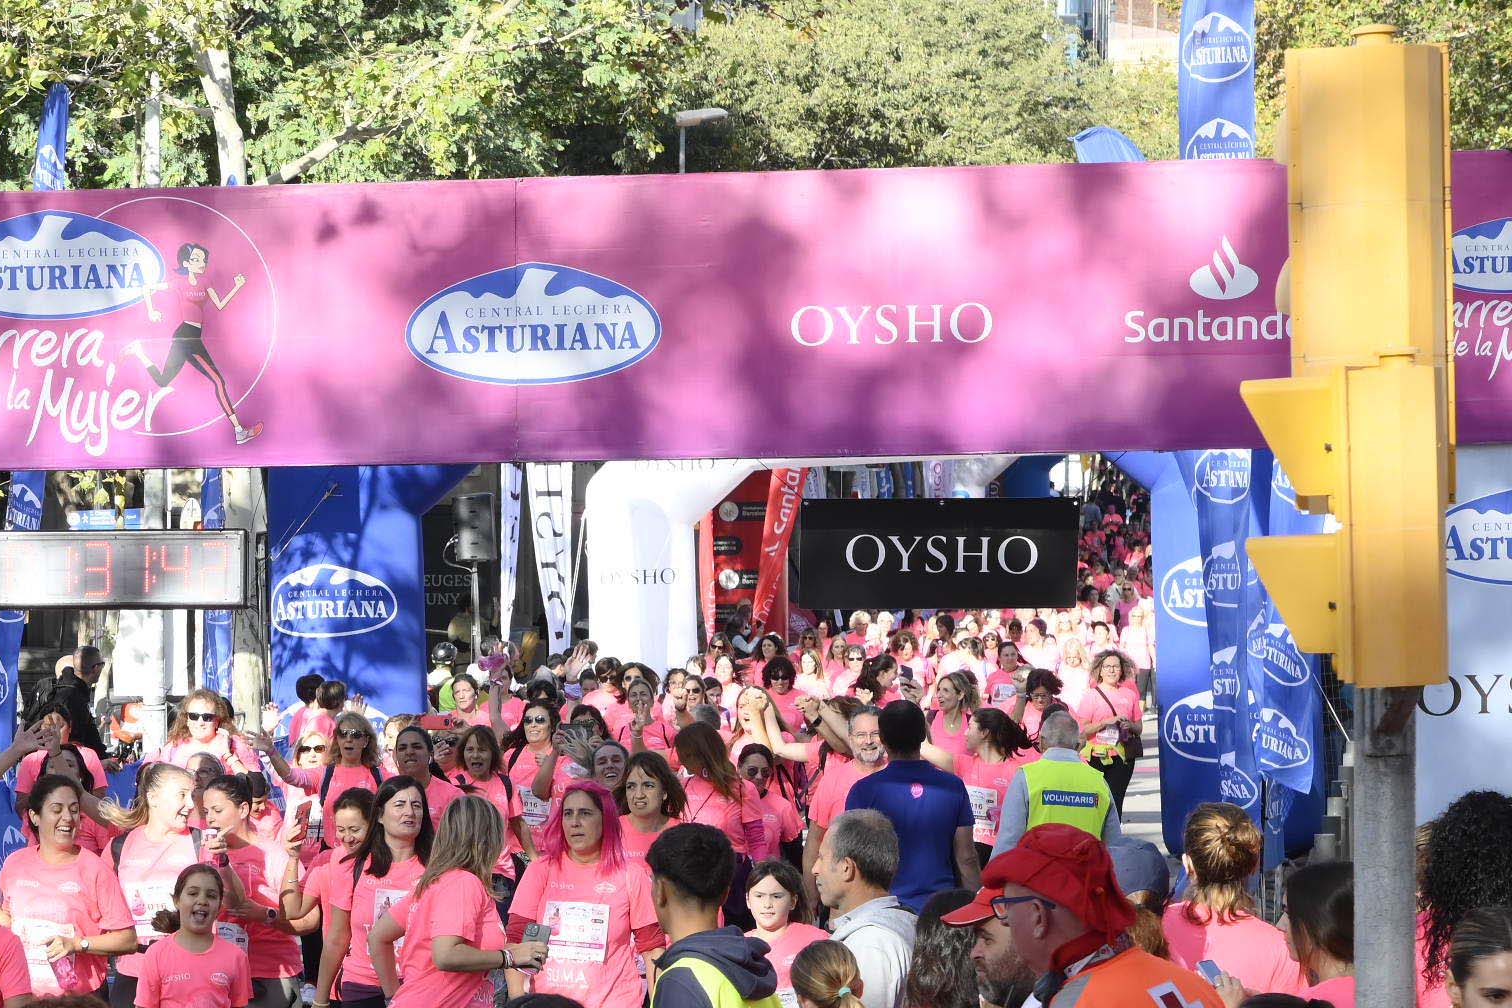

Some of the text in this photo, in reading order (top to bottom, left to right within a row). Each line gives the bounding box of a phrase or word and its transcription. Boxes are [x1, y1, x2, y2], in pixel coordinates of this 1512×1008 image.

[67, 246, 141, 259] LECHERA
[1465, 244, 1512, 252] CENTRA
[464, 303, 633, 319] CENTRAL LECHERA
[790, 301, 993, 347] OYSHO
[425, 310, 641, 356] ASTURIANA
[1475, 329, 1493, 357] la
[6, 373, 31, 411] la
[26, 366, 173, 457] Mujer
[843, 533, 1039, 575] OYSHO
[287, 587, 384, 598] CENTRAL LECHERA
[275, 599, 387, 623] ASTURIANA
[1043, 794, 1094, 806] VOLUNTARIS
